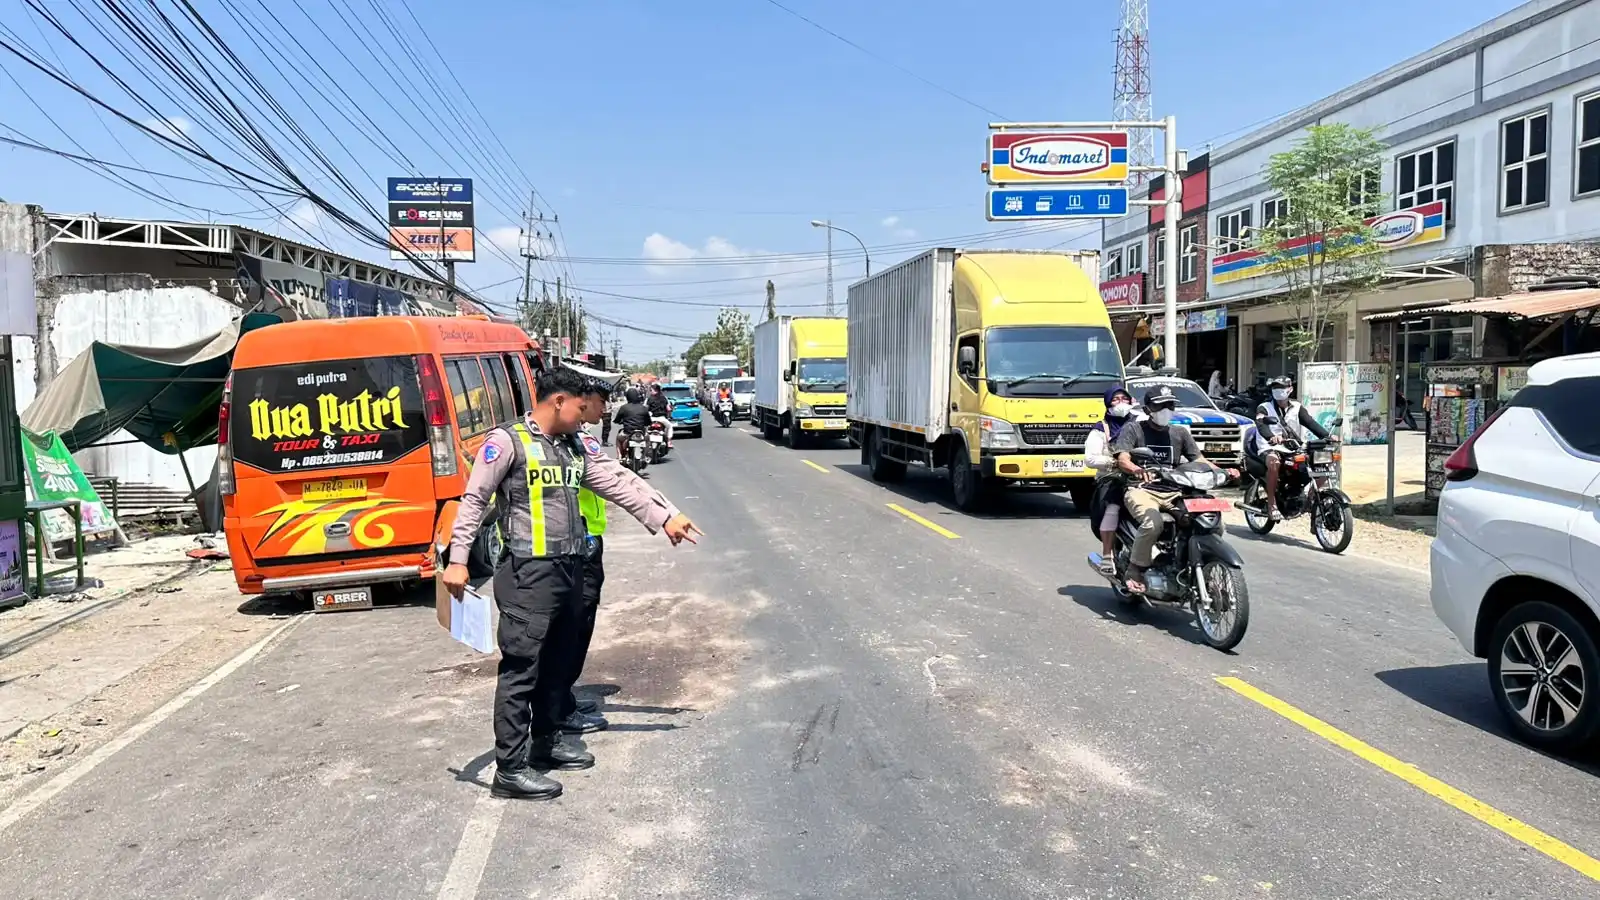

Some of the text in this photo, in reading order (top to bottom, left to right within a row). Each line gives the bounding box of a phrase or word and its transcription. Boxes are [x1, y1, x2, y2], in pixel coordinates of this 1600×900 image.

[1015, 146, 1103, 165] Indomaret
[409, 231, 458, 244] ZEETX
[297, 372, 347, 386] edi putra
[249, 386, 410, 441] Dua Putri
[273, 433, 381, 452] TOUR & TAXI
